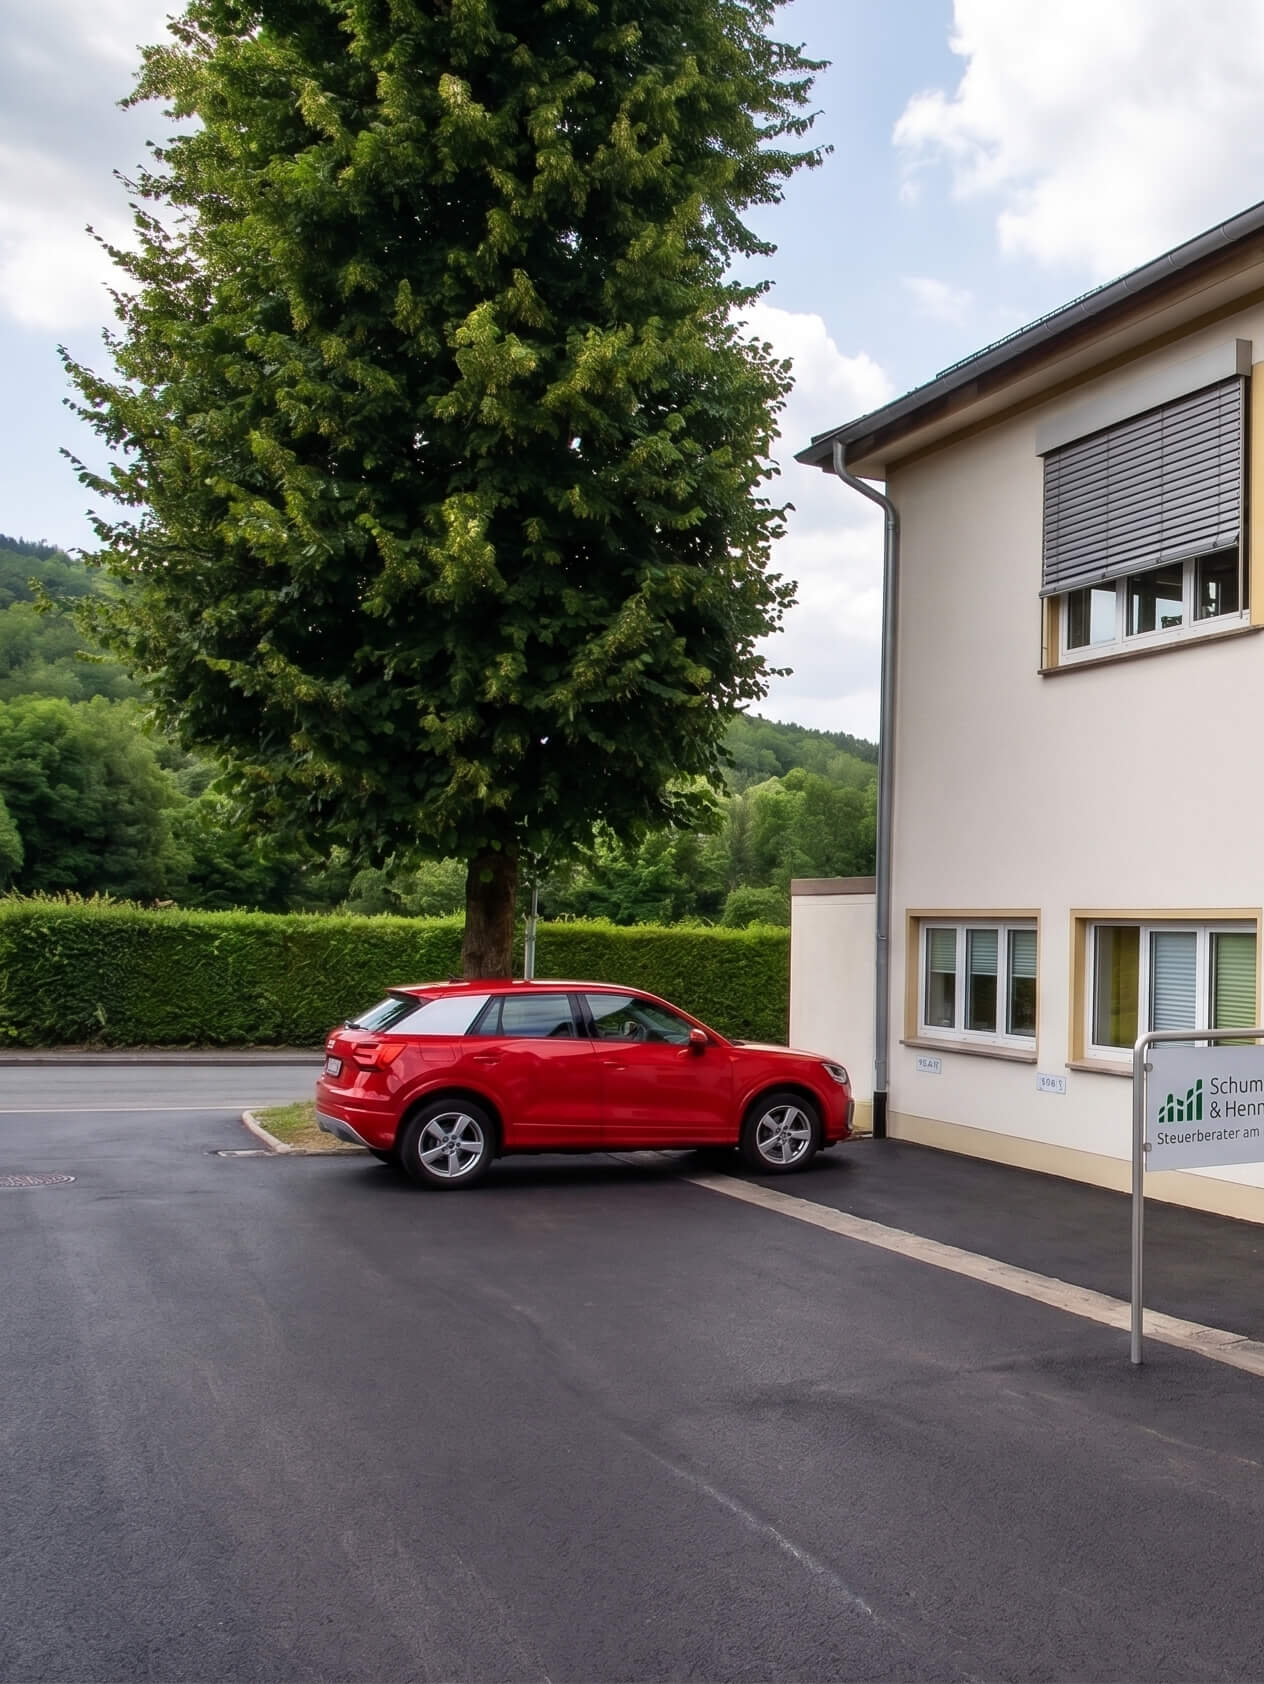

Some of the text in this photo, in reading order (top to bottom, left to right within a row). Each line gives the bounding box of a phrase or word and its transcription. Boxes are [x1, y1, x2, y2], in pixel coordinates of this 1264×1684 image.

[1209, 1100, 1221, 1119] &
[1157, 1127, 1240, 1145] Steuerberater
[1243, 1126, 1260, 1138] am
